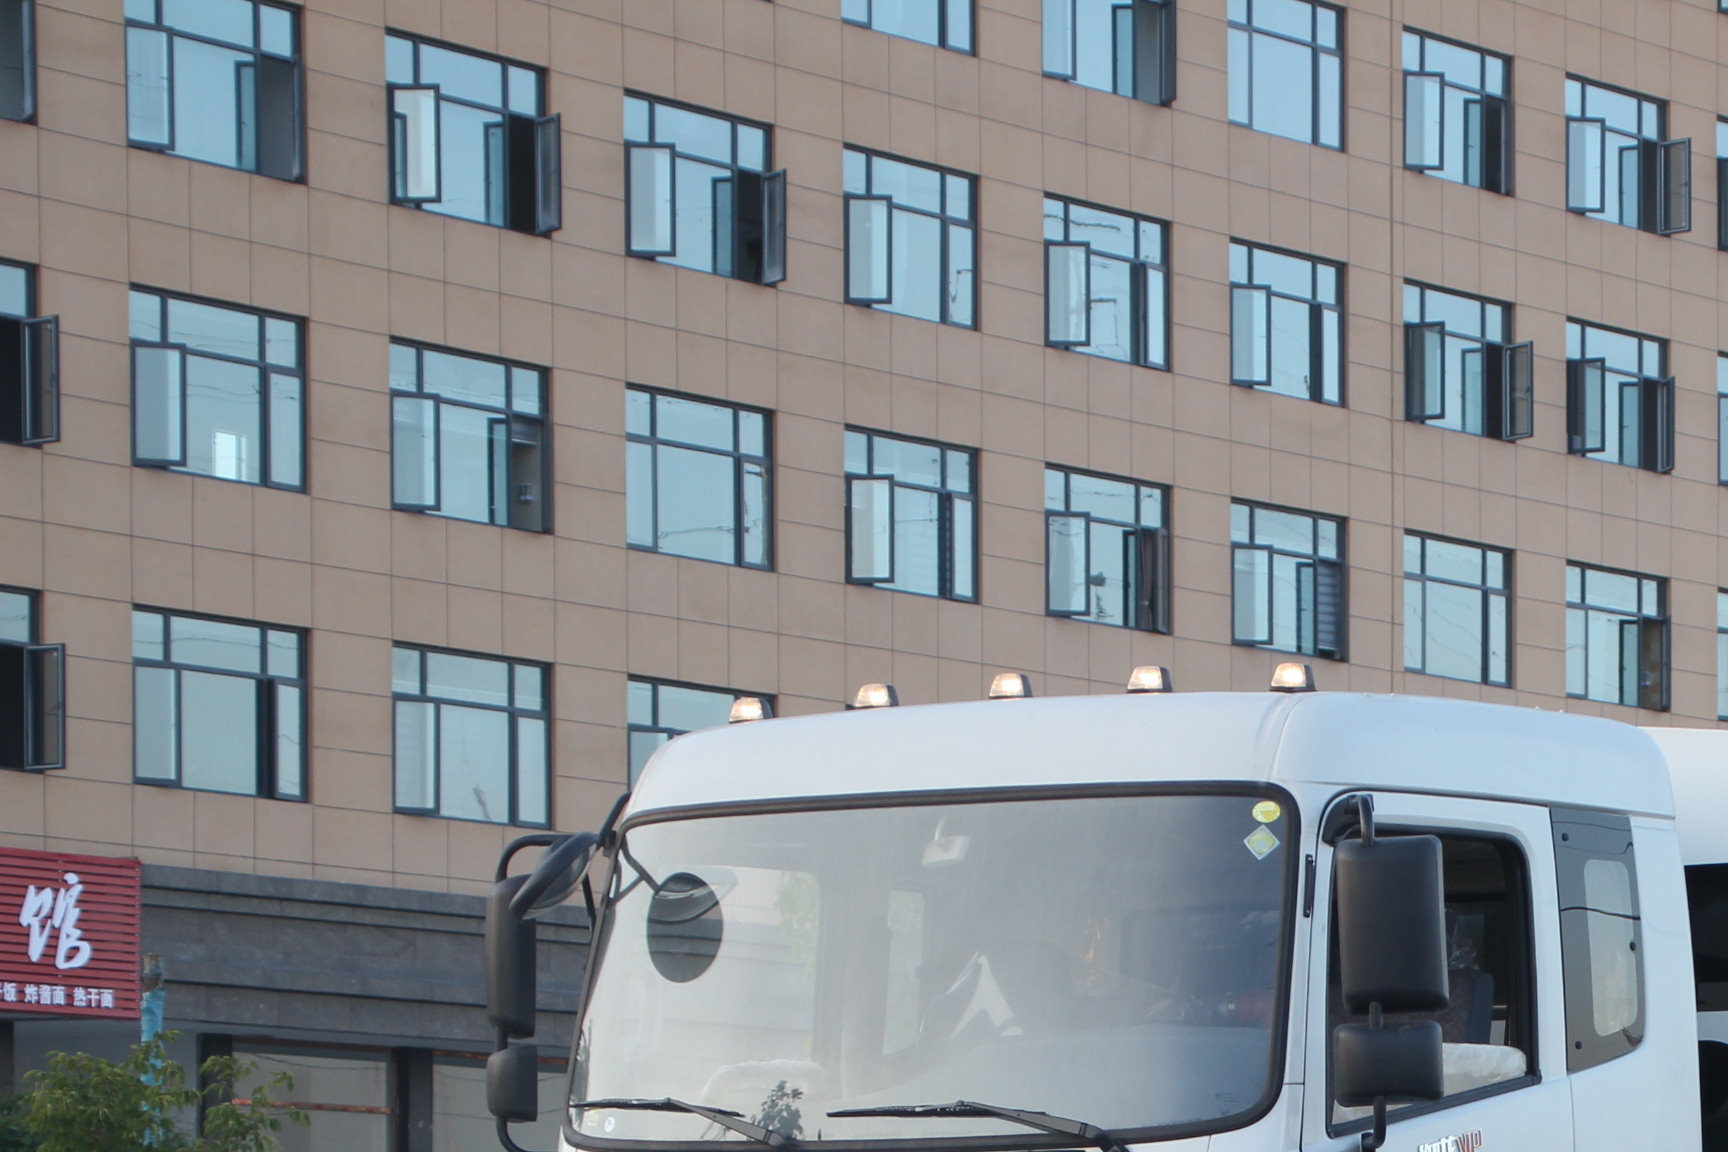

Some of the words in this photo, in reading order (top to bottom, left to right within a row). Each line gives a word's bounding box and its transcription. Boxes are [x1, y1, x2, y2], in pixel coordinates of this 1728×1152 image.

[19, 872, 92, 970] 馆
[24, 984, 66, 1005] 炸酱面
[73, 986, 114, 1009] 热干面
